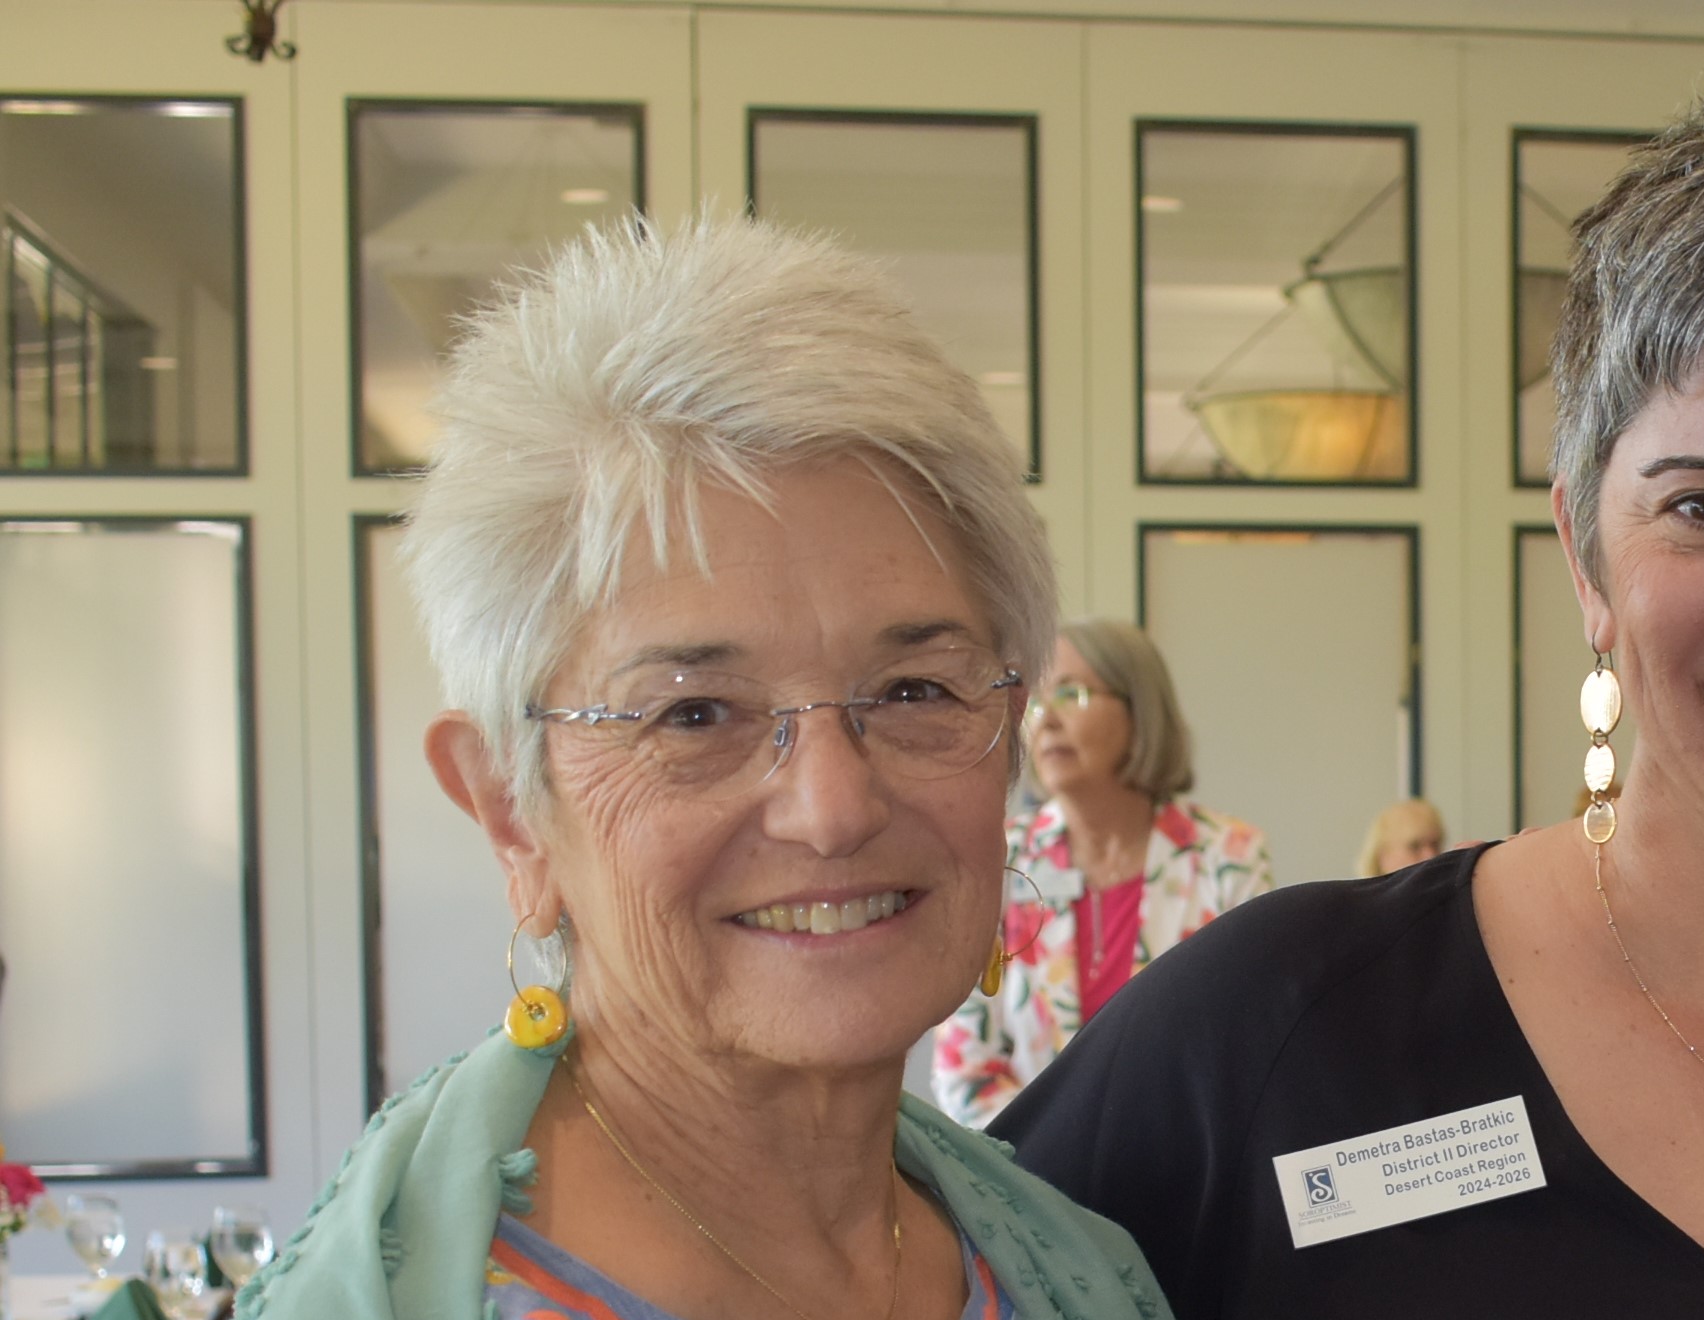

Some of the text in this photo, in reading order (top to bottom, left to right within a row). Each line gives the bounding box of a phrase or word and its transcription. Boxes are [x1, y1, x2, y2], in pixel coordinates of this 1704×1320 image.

[1335, 1110, 1516, 1167] Demetra Bastas-Bratkic
[1382, 1150, 1441, 1177] District
[1456, 1132, 1520, 1158] Director
[1384, 1150, 1527, 1196] Desert Coast Region
[1457, 1167, 1532, 1197] 2024-2026
